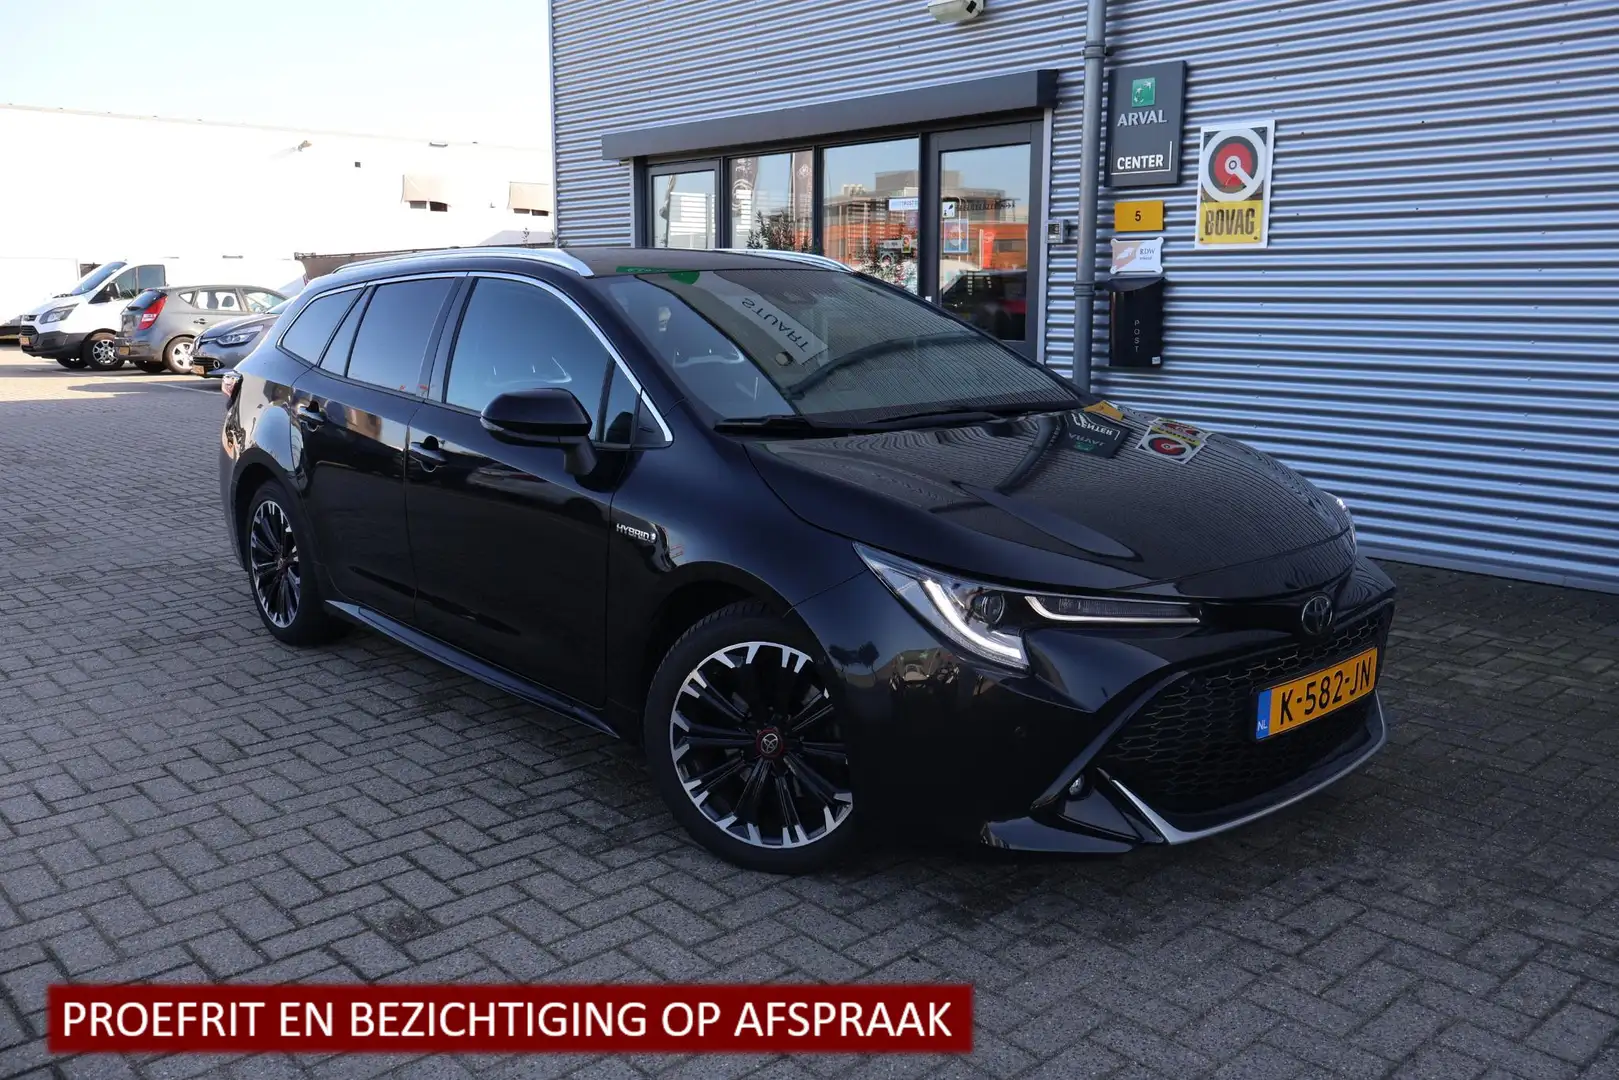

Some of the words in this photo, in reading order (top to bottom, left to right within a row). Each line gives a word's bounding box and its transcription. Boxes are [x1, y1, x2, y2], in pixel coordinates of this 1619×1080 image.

[1117, 109, 1168, 127] ARVAL
[1117, 154, 1164, 170] CENTER
[1134, 210, 1142, 222] 5
[1204, 207, 1256, 236] BOVAG
[1133, 319, 1141, 353] POST
[616, 523, 650, 542] HYBRID
[1257, 719, 1268, 732] NL
[1280, 656, 1372, 725] K-582-JN
